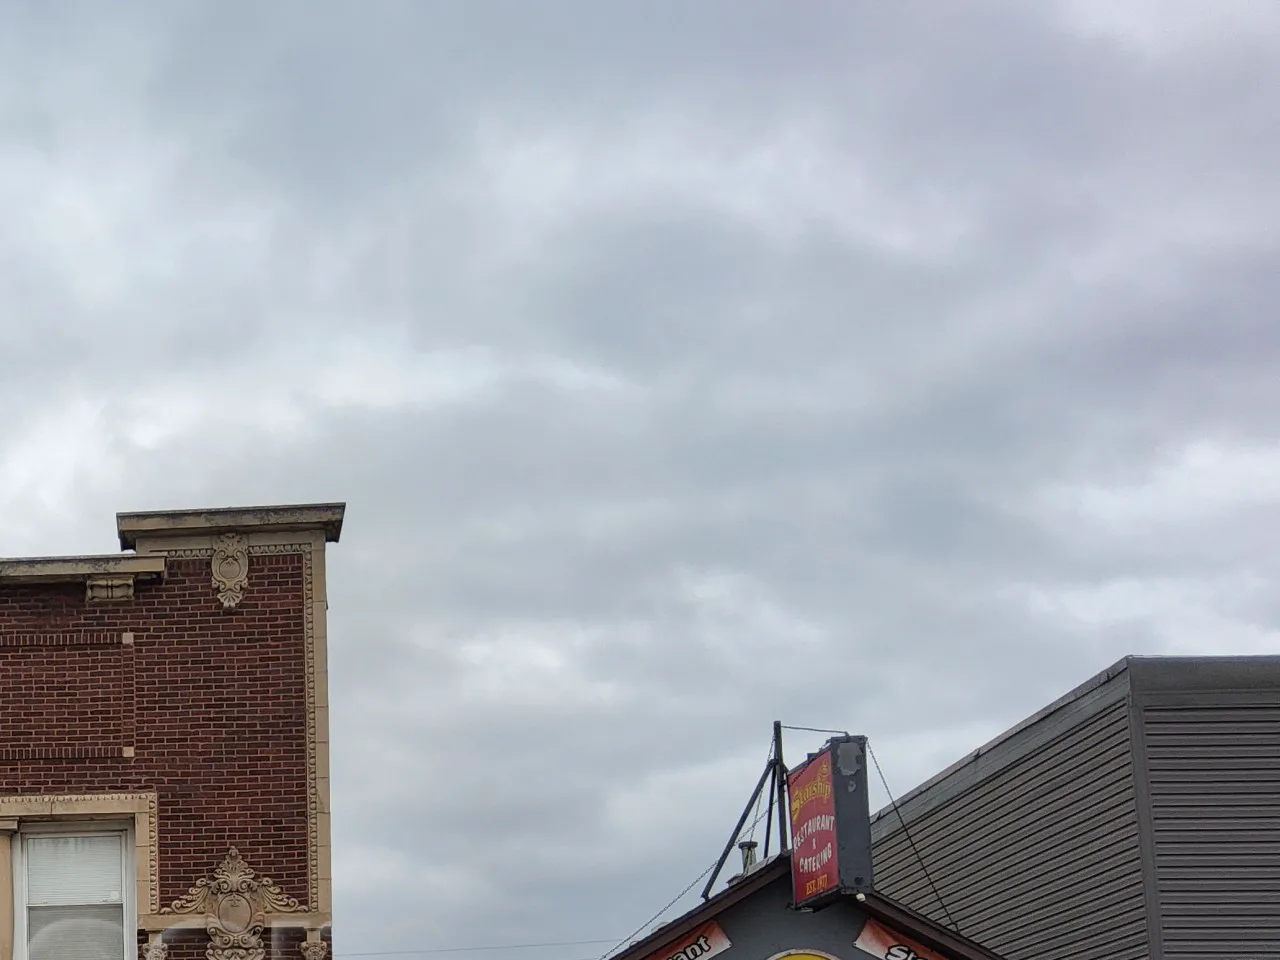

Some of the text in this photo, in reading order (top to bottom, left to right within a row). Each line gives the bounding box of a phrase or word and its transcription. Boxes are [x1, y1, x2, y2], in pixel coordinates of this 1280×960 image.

[792, 776, 831, 822] Starship
[793, 814, 835, 853] RESTAURANT
[799, 842, 832, 874] CATERING
